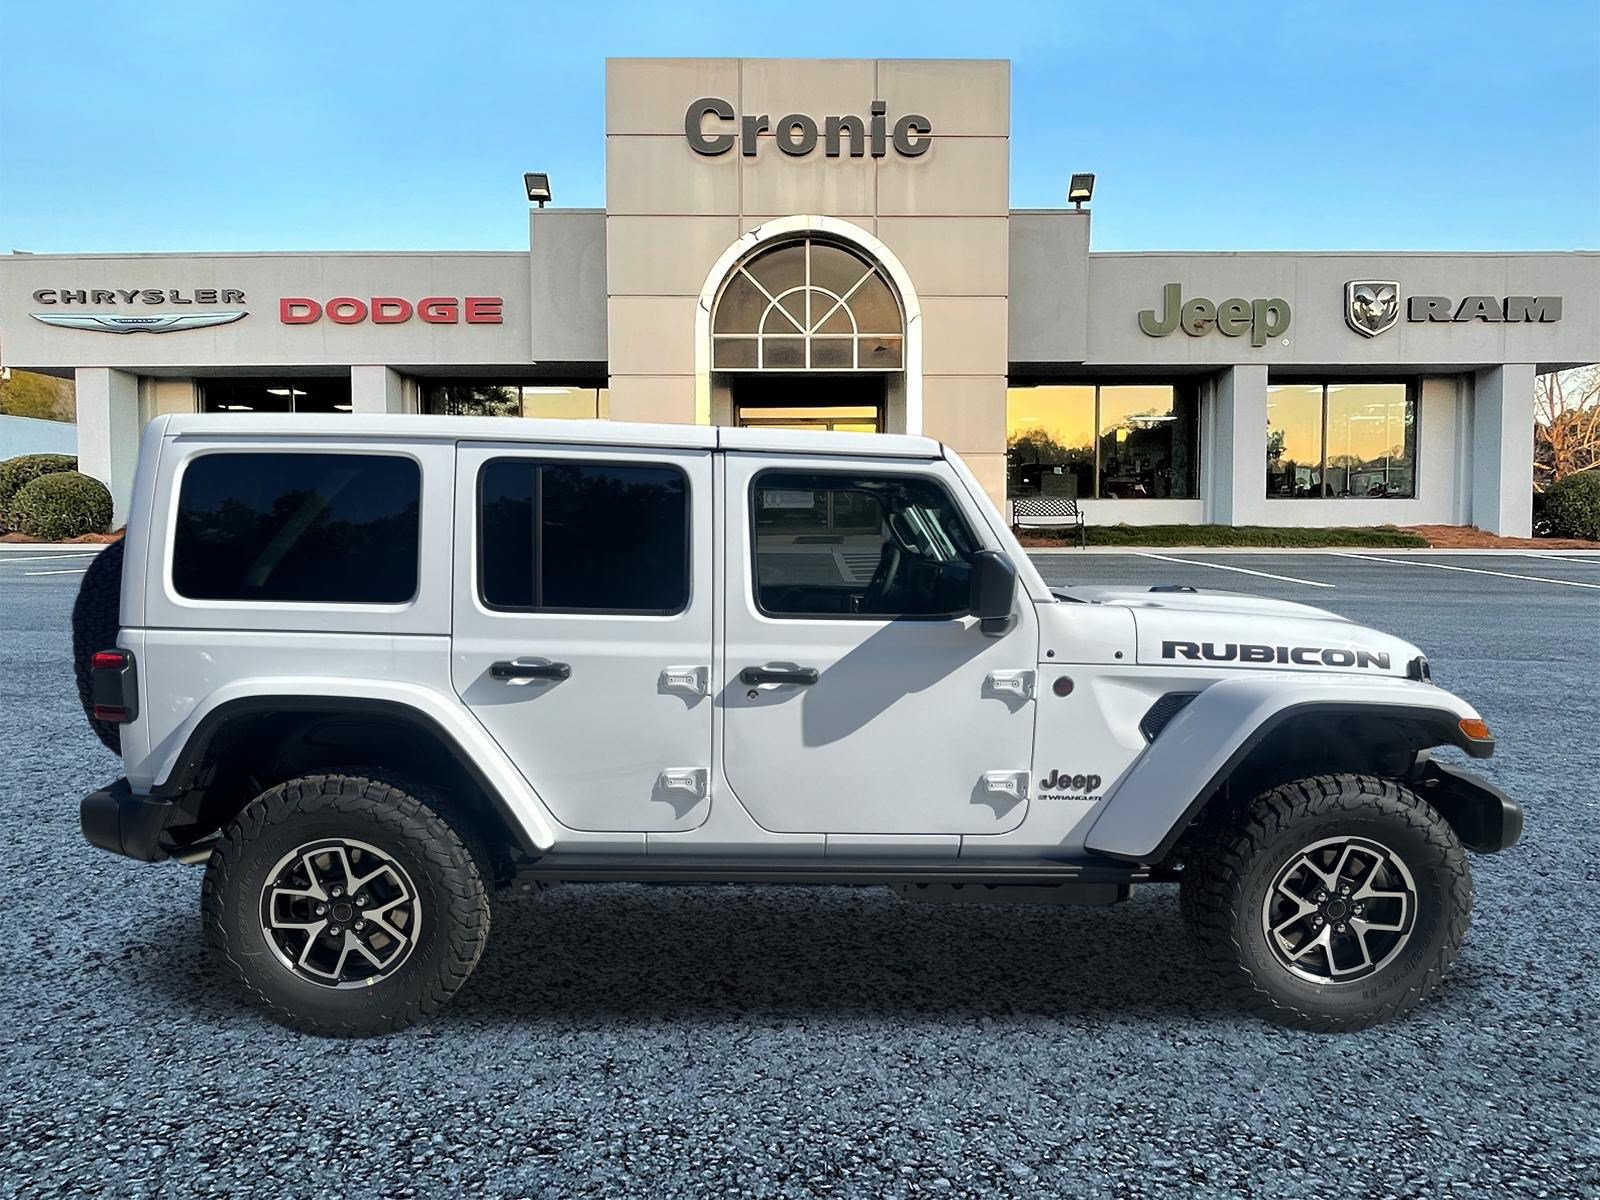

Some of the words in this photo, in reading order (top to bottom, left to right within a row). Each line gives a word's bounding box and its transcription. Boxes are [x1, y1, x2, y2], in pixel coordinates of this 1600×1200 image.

[685, 97, 932, 158] Cronic
[32, 288, 247, 305] CHRYSLER
[1407, 296, 1563, 322] RAM
[280, 297, 503, 325] DODGE
[1138, 283, 1291, 347] Jeep
[1161, 640, 1391, 670] RUBICON
[1040, 769, 1102, 793] Jeep
